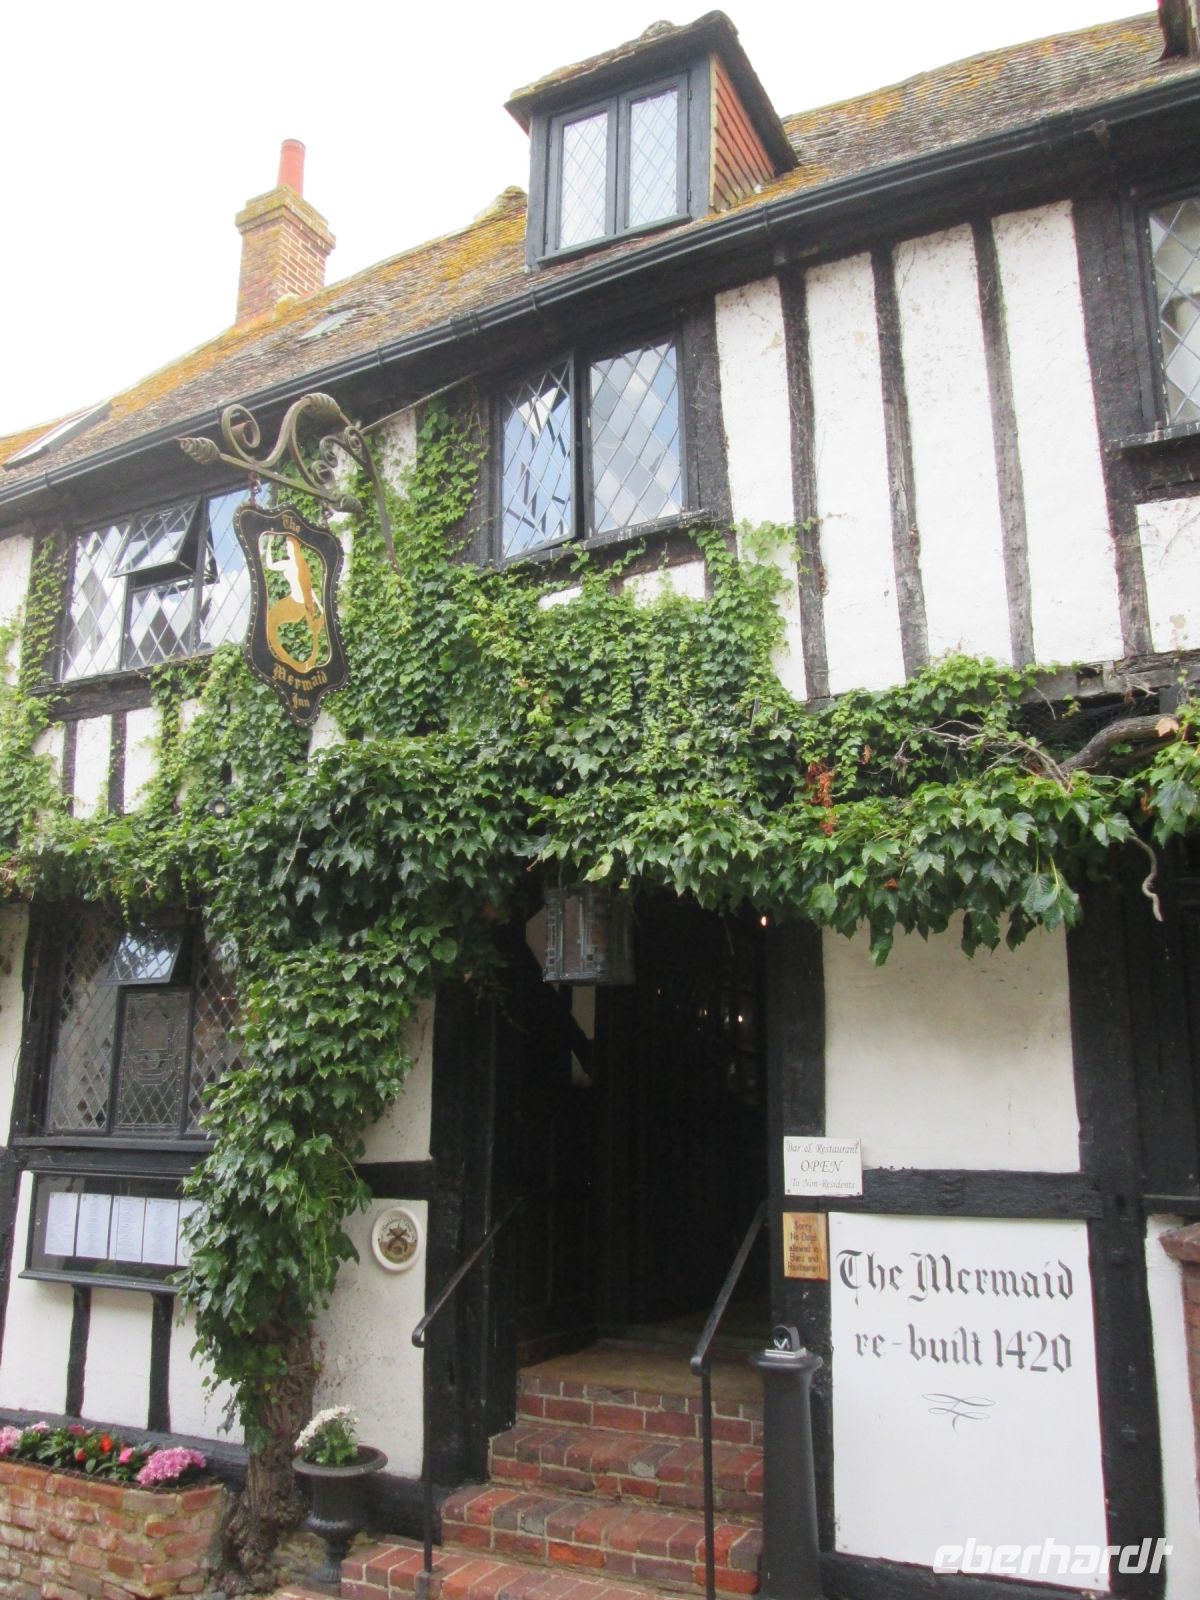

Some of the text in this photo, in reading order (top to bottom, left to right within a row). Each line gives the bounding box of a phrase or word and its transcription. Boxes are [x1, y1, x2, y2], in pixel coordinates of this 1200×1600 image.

[282, 514, 301, 533] The
[272, 663, 328, 691] Mermaid
[292, 693, 310, 709] Inn
[786, 1142, 801, 1153] Bar
[816, 1143, 859, 1155] Restaurant
[800, 1159, 843, 1174] OPEN
[836, 1249, 1074, 1312] The Mermaid
[855, 1323, 1073, 1374] re-built 1420
